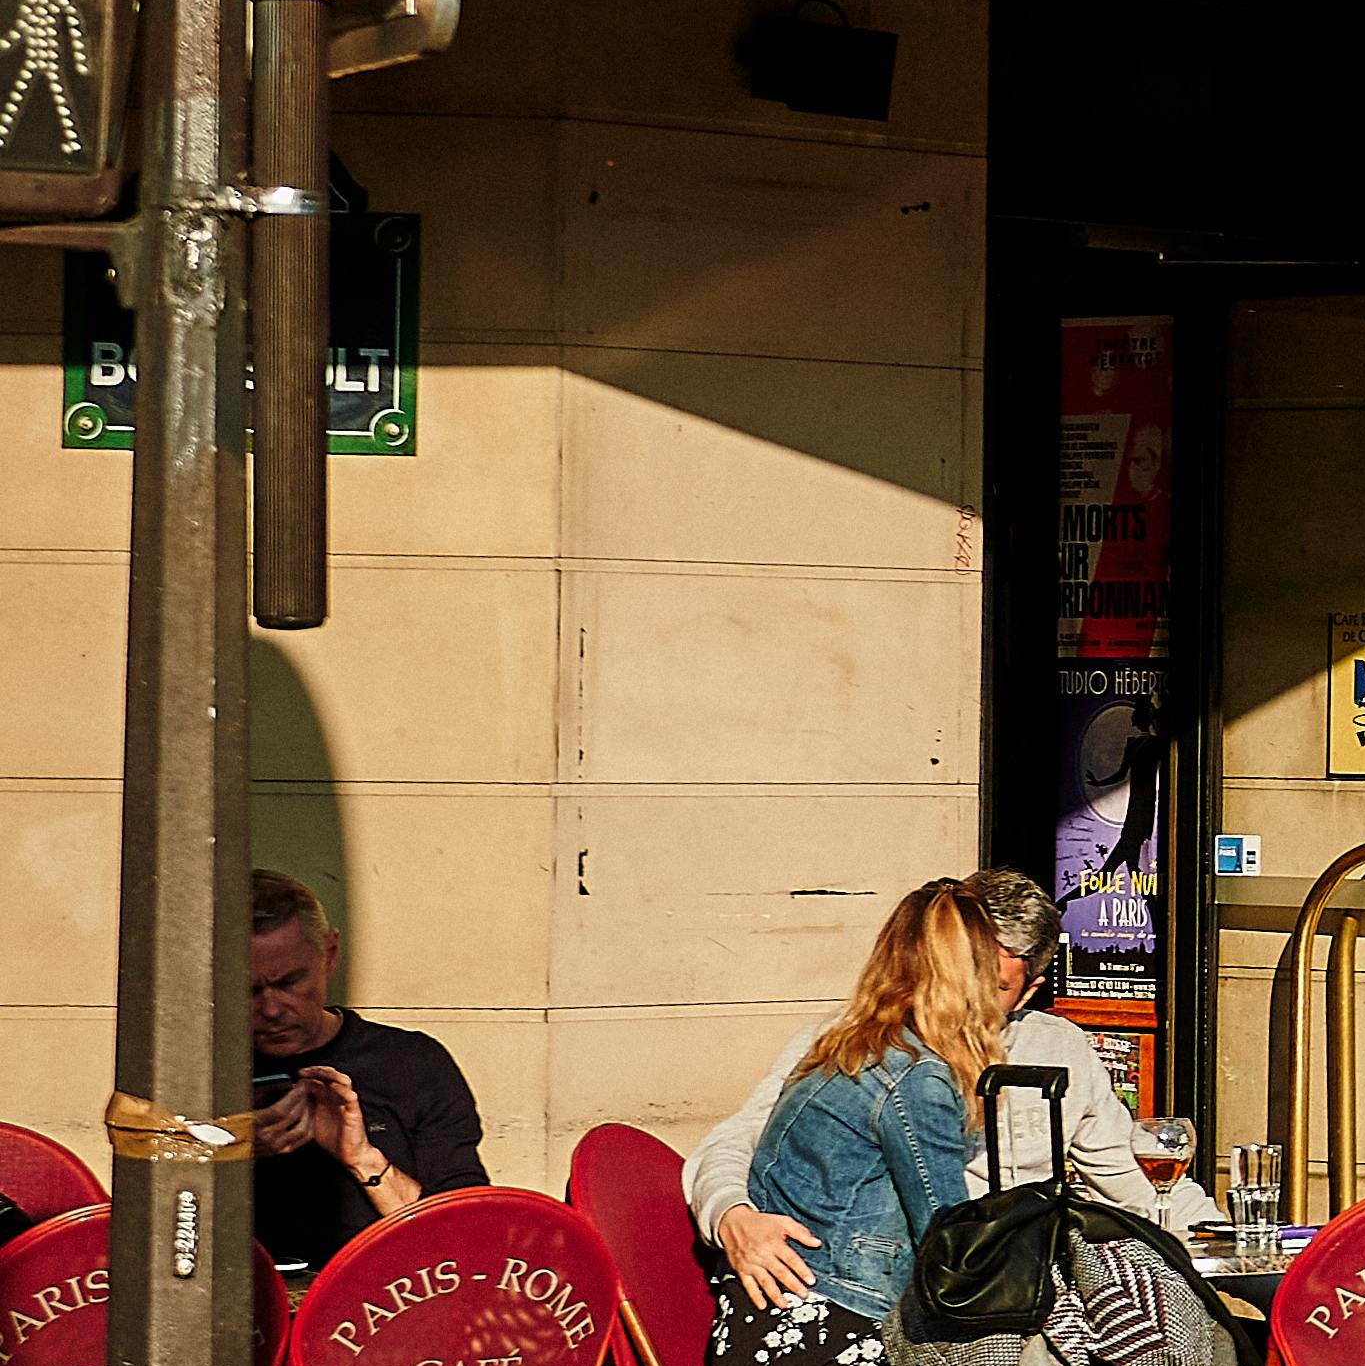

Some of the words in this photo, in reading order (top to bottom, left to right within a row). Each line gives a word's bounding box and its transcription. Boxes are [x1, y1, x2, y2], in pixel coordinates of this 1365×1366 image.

[1063, 504, 1146, 542] MORTS
[1056, 543, 1089, 580] UR
[1057, 669, 1108, 695] TUDIO
[1080, 869, 1125, 897] FOLLE
[1098, 899, 1108, 927] A
[1112, 897, 1149, 928] PARIS
[329, 1260, 462, 1357] PARIS
[496, 1257, 595, 1349] ROME
